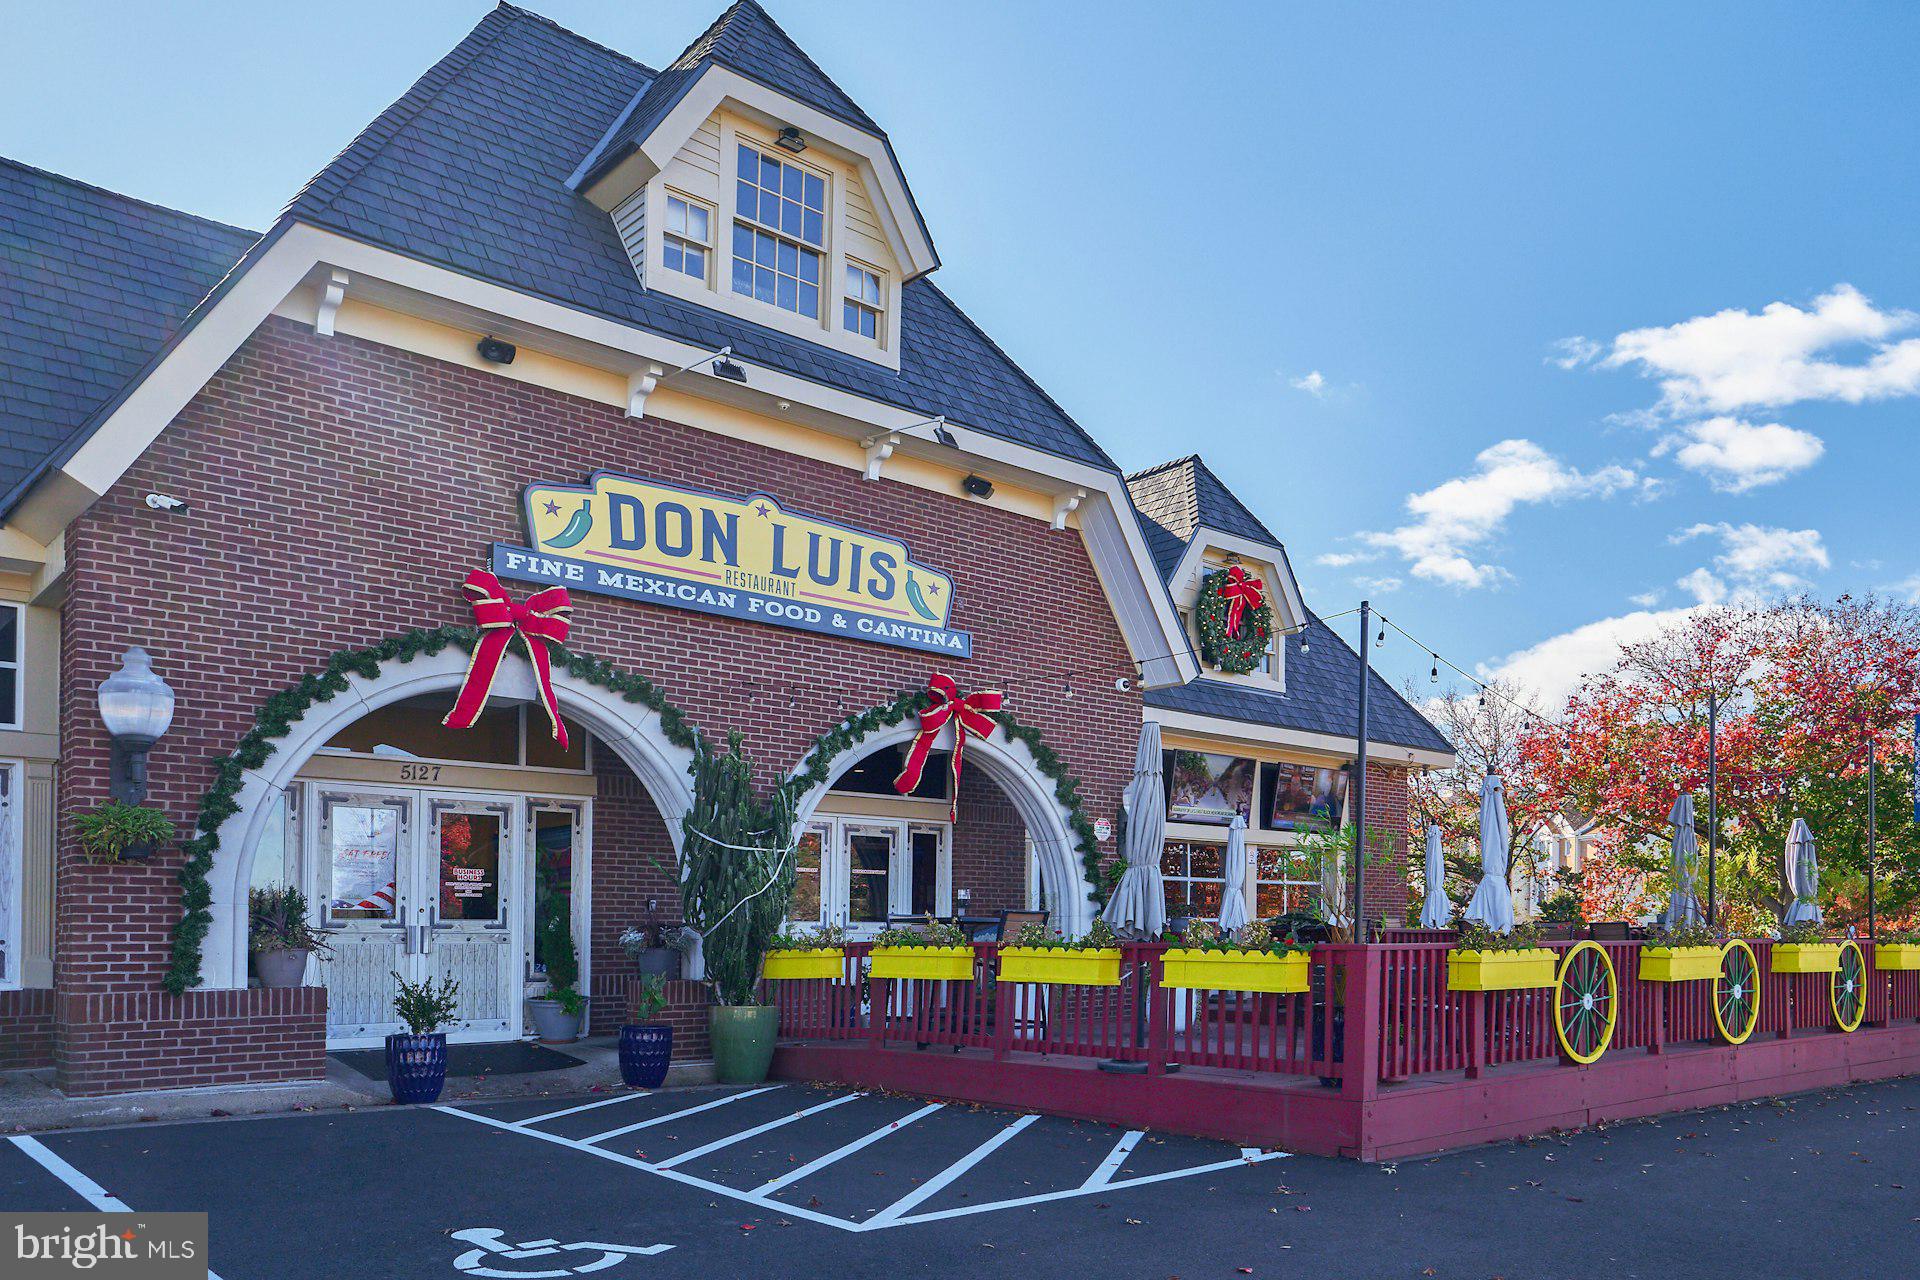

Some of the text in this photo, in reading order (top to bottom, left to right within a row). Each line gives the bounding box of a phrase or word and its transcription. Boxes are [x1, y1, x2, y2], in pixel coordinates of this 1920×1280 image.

[605, 491, 897, 601] DON LUIS
[725, 569, 796, 597] RESTAURANT
[506, 552, 963, 650] FINE MEXICAN FOOD & CANTINA
[400, 764, 442, 781] 5127
[453, 868, 484, 876] BUSINESS
